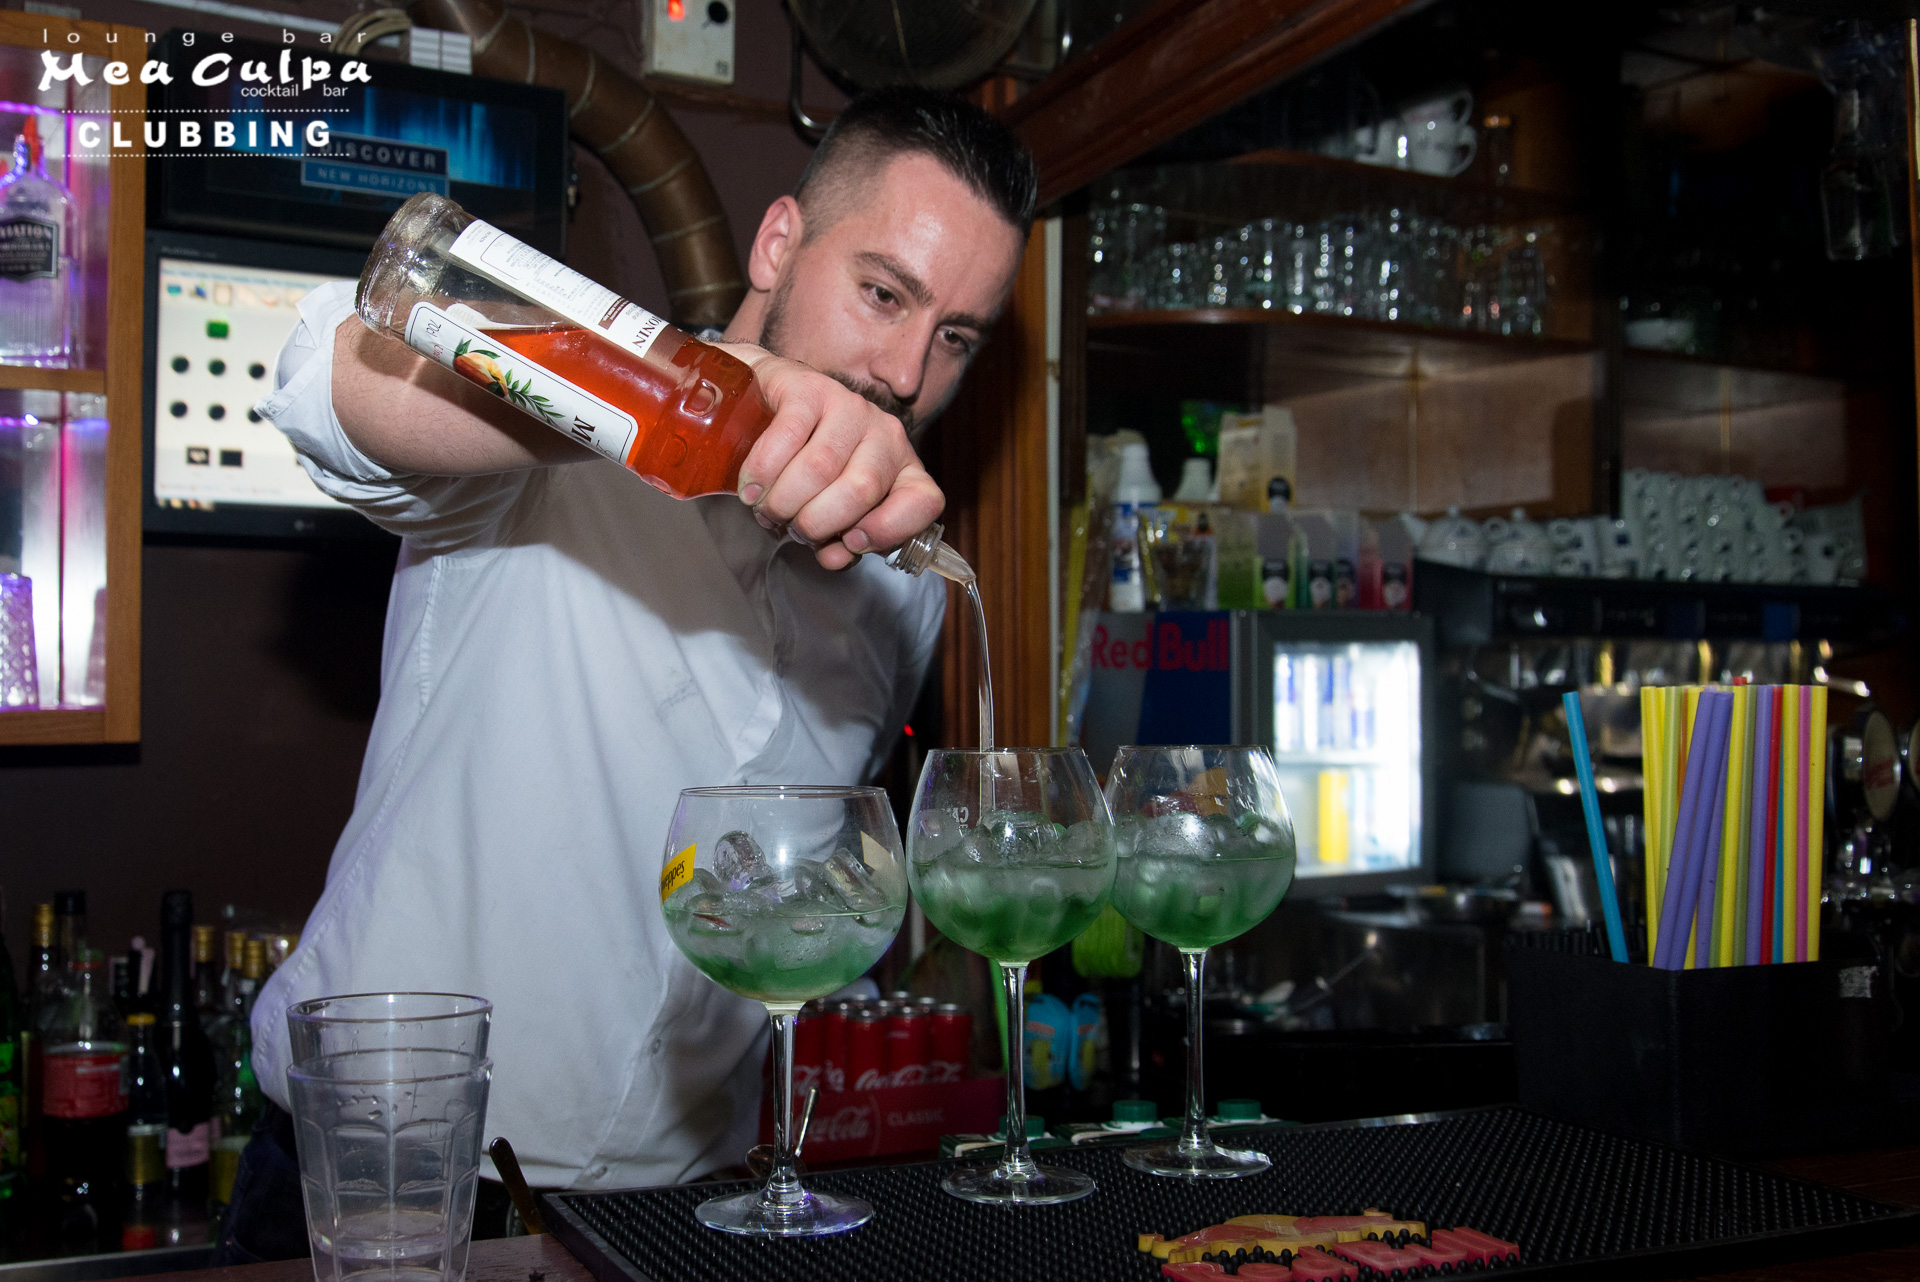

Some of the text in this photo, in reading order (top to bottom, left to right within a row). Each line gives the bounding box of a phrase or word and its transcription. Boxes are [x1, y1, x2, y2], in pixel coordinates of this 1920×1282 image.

[319, 141, 437, 170] DISCOVER
[318, 167, 350, 182] NEW
[1091, 619, 1229, 671] Red Bull
